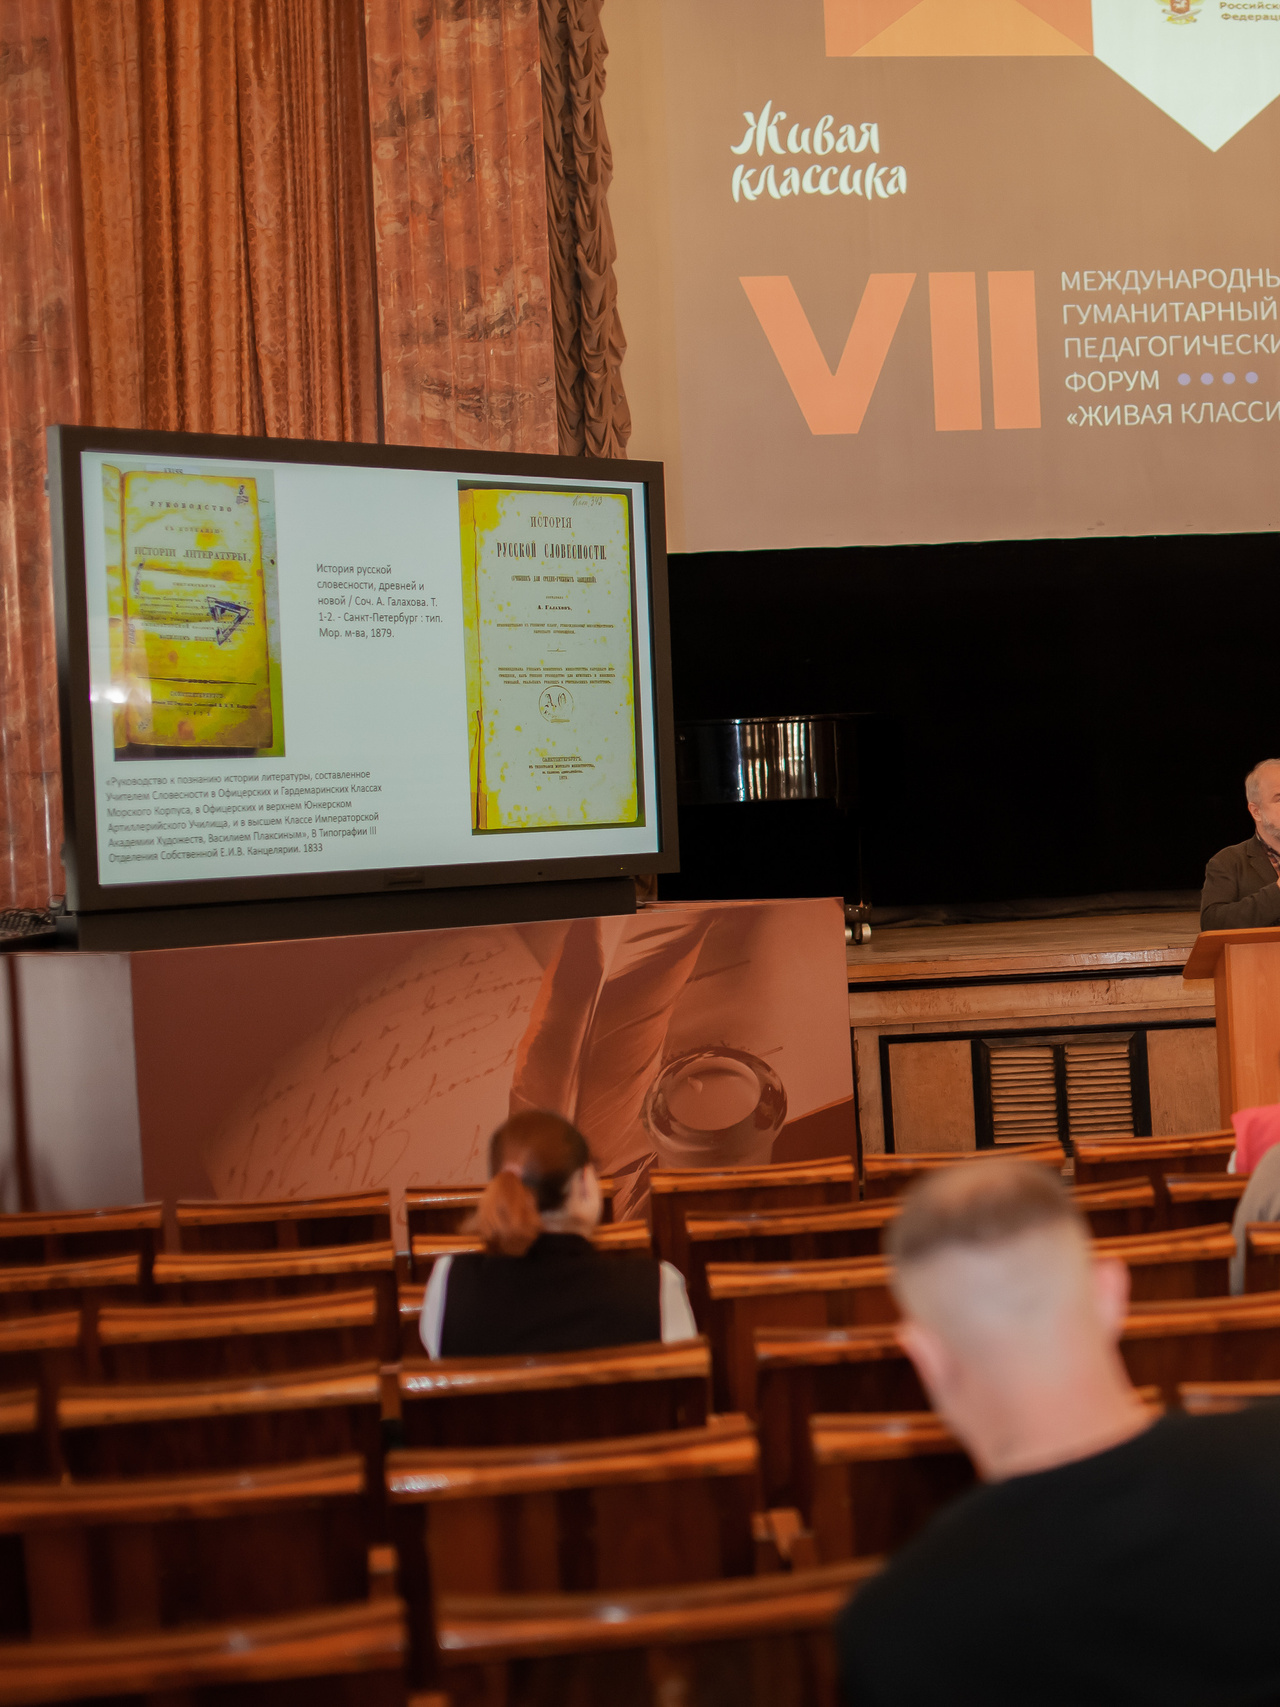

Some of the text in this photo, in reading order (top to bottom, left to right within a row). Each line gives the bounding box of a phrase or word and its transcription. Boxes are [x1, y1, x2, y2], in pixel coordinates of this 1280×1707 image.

[730, 100, 880, 157] Живая
[732, 162, 907, 203] классика
[1062, 296, 1278, 325] ГУМАНИТАРНЫЙ
[738, 270, 1042, 436] VII
[1065, 370, 1160, 393] ФОРУМ
[1066, 403, 1172, 427] «ЖИВАЯ
[496, 541, 537, 558] РУССКОЙ
[316, 564, 392, 576] История русской
[317, 581, 376, 591] словесности,
[378, 581, 417, 592] древней
[318, 596, 346, 605] новой
[355, 596, 373, 606] Соч.
[376, 597, 385, 606] А.
[387, 597, 429, 607] Галахова.
[430, 598, 438, 607] Т.
[318, 612, 335, 622] 1-2.
[343, 612, 418, 625] Санкт-Петербург
[425, 615, 443, 623] тип.
[319, 628, 394, 639] Мор. м-ва, 1879.
[224, 775, 259, 784] истории
[260, 772, 313, 783] литературы,
[314, 771, 371, 780] составленное
[152, 790, 209, 800] Словесности
[218, 788, 271, 799] Офицерских
[281, 785, 349, 797] Гардемаринских
[351, 784, 382, 793] Классах
[202, 804, 256, 815] Офицерских
[266, 802, 302, 812] верхнем
[304, 800, 352, 810] Юнкерском
[247, 818, 282, 826] высшем
[285, 816, 313, 824] Классе
[315, 812, 379, 824] Императорской
[208, 834, 251, 843] Василием
[319, 827, 368, 839] Типографии
[160, 848, 218, 860] Собственной
[220, 847, 245, 857] Е.И.В.
[247, 845, 301, 857] Канцелярии.
[303, 843, 323, 853] 1833
